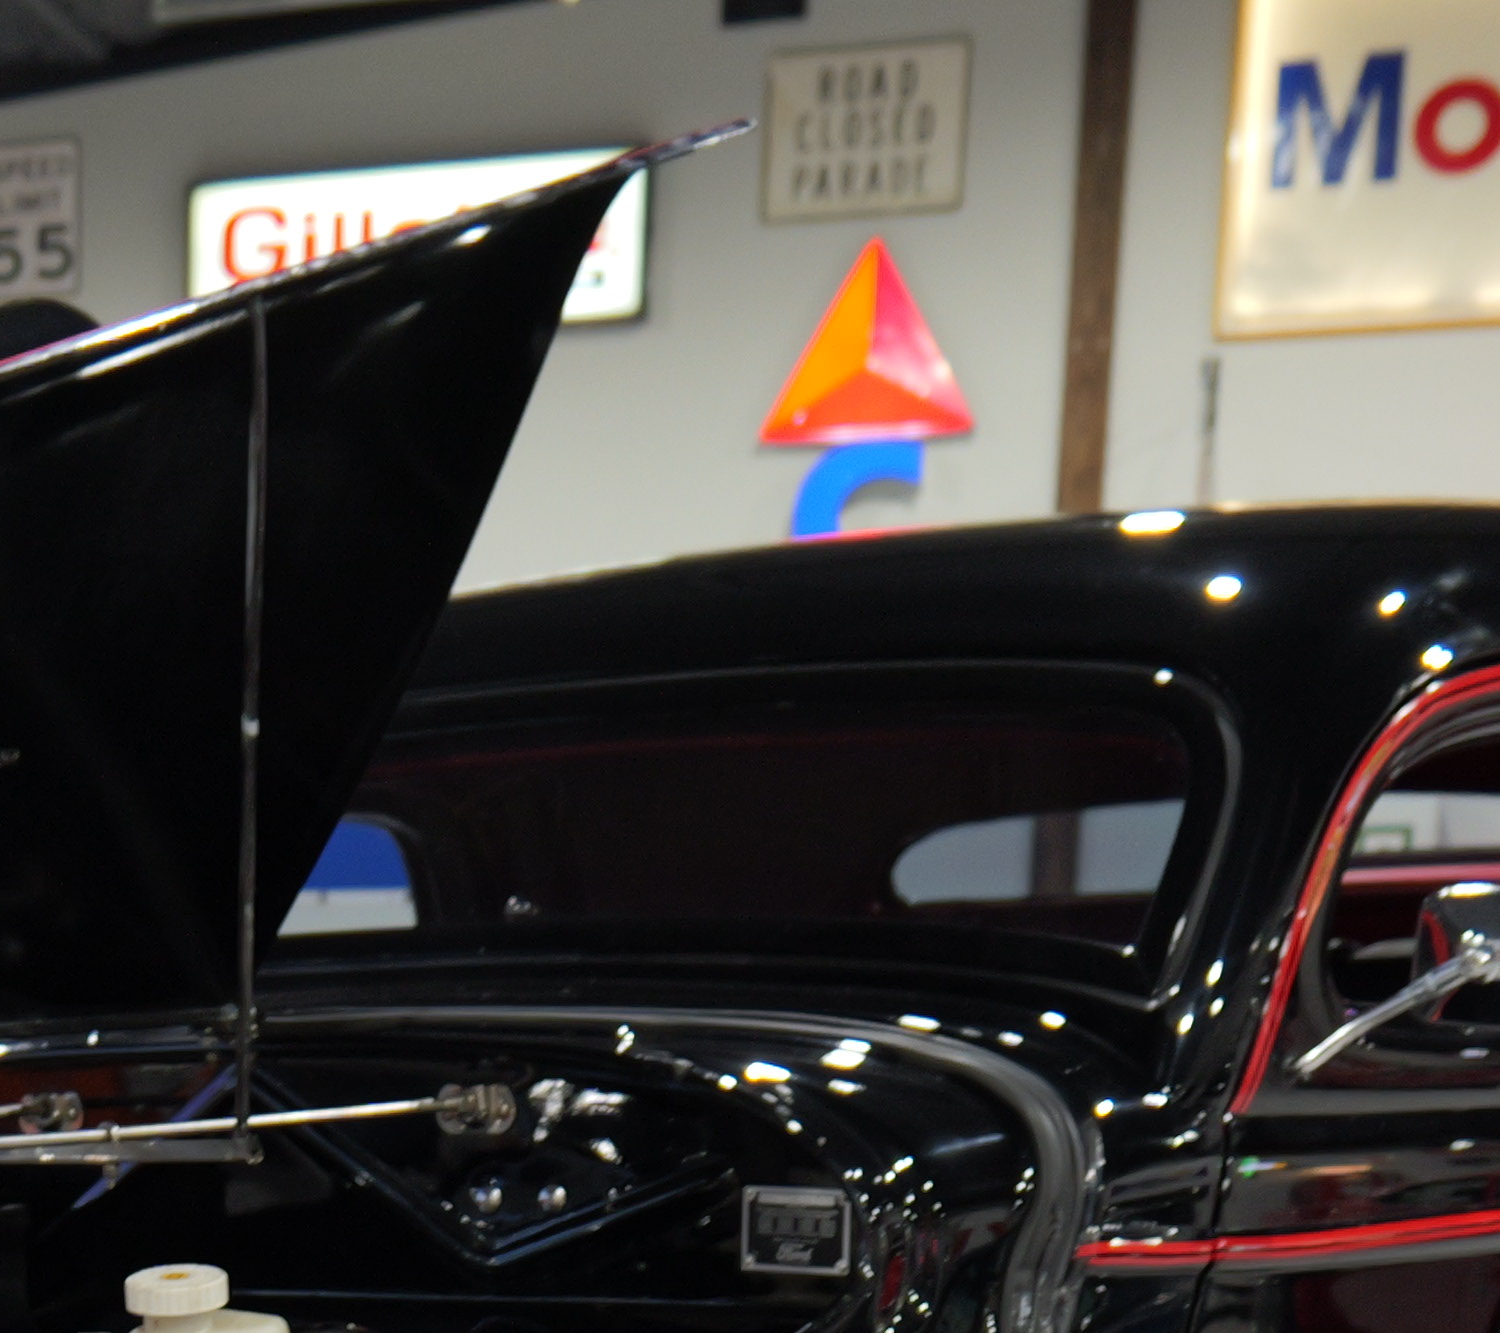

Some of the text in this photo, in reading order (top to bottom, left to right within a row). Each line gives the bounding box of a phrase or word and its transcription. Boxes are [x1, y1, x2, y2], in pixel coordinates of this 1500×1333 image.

[817, 58, 920, 102] ROAD
[796, 102, 937, 154] CLOSED
[791, 154, 929, 199] PARADE
